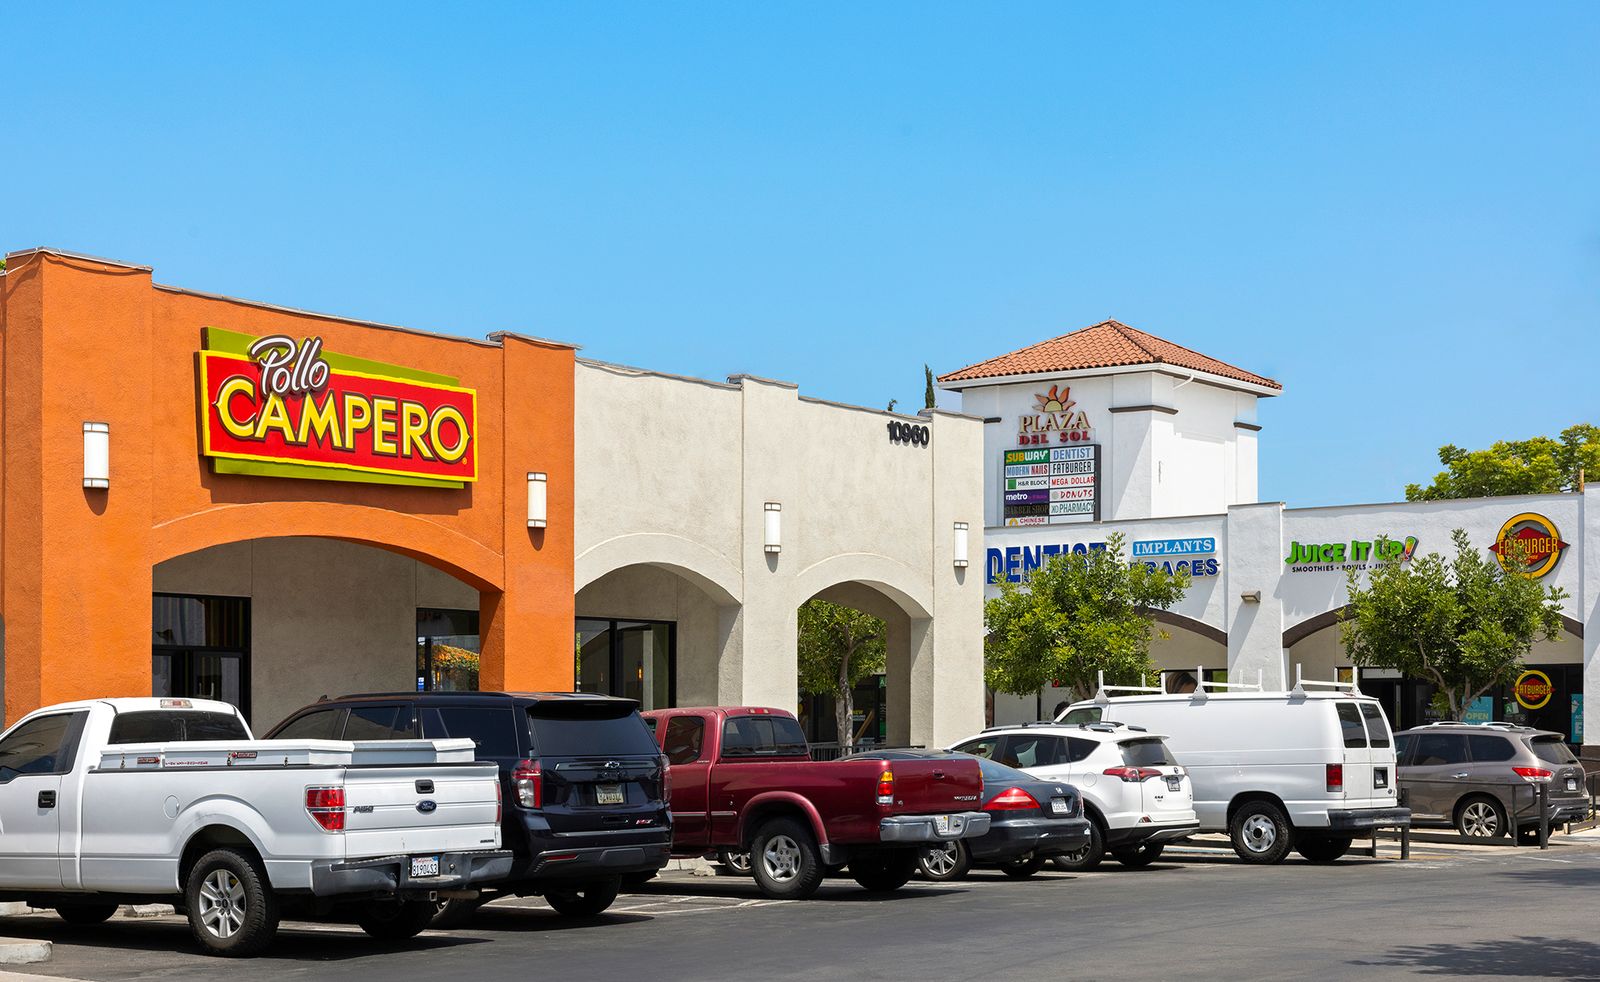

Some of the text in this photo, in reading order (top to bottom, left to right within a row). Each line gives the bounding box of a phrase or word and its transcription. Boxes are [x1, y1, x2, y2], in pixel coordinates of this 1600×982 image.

[250, 336, 329, 396] Pollo
[213, 376, 471, 461] CAMPERO
[1019, 412, 1091, 433] PLAZA
[887, 420, 930, 446] 10960
[1019, 430, 1090, 445] DEL SOL
[1006, 450, 1048, 463] SUBWAY
[1053, 447, 1091, 460] DENTIST
[1006, 464, 1048, 477] MODERN NAILS
[1052, 461, 1092, 474] FATBURGER
[1051, 476, 1095, 486] MEGA DOLLAR
[1005, 492, 1028, 501] metro
[1060, 489, 1093, 499] DONUTS
[1059, 502, 1095, 513] PHARMACY
[1135, 539, 1212, 554] IMPLANTS
[1285, 541, 1345, 564] JUICE
[1351, 540, 1370, 561] IT
[986, 542, 1107, 585] DENT
[1130, 558, 1218, 577] RACES
[1292, 565, 1334, 573] SMOOTHIES
[1516, 684, 1551, 695] FATBURGER
[1466, 712, 1489, 720] OPEN
